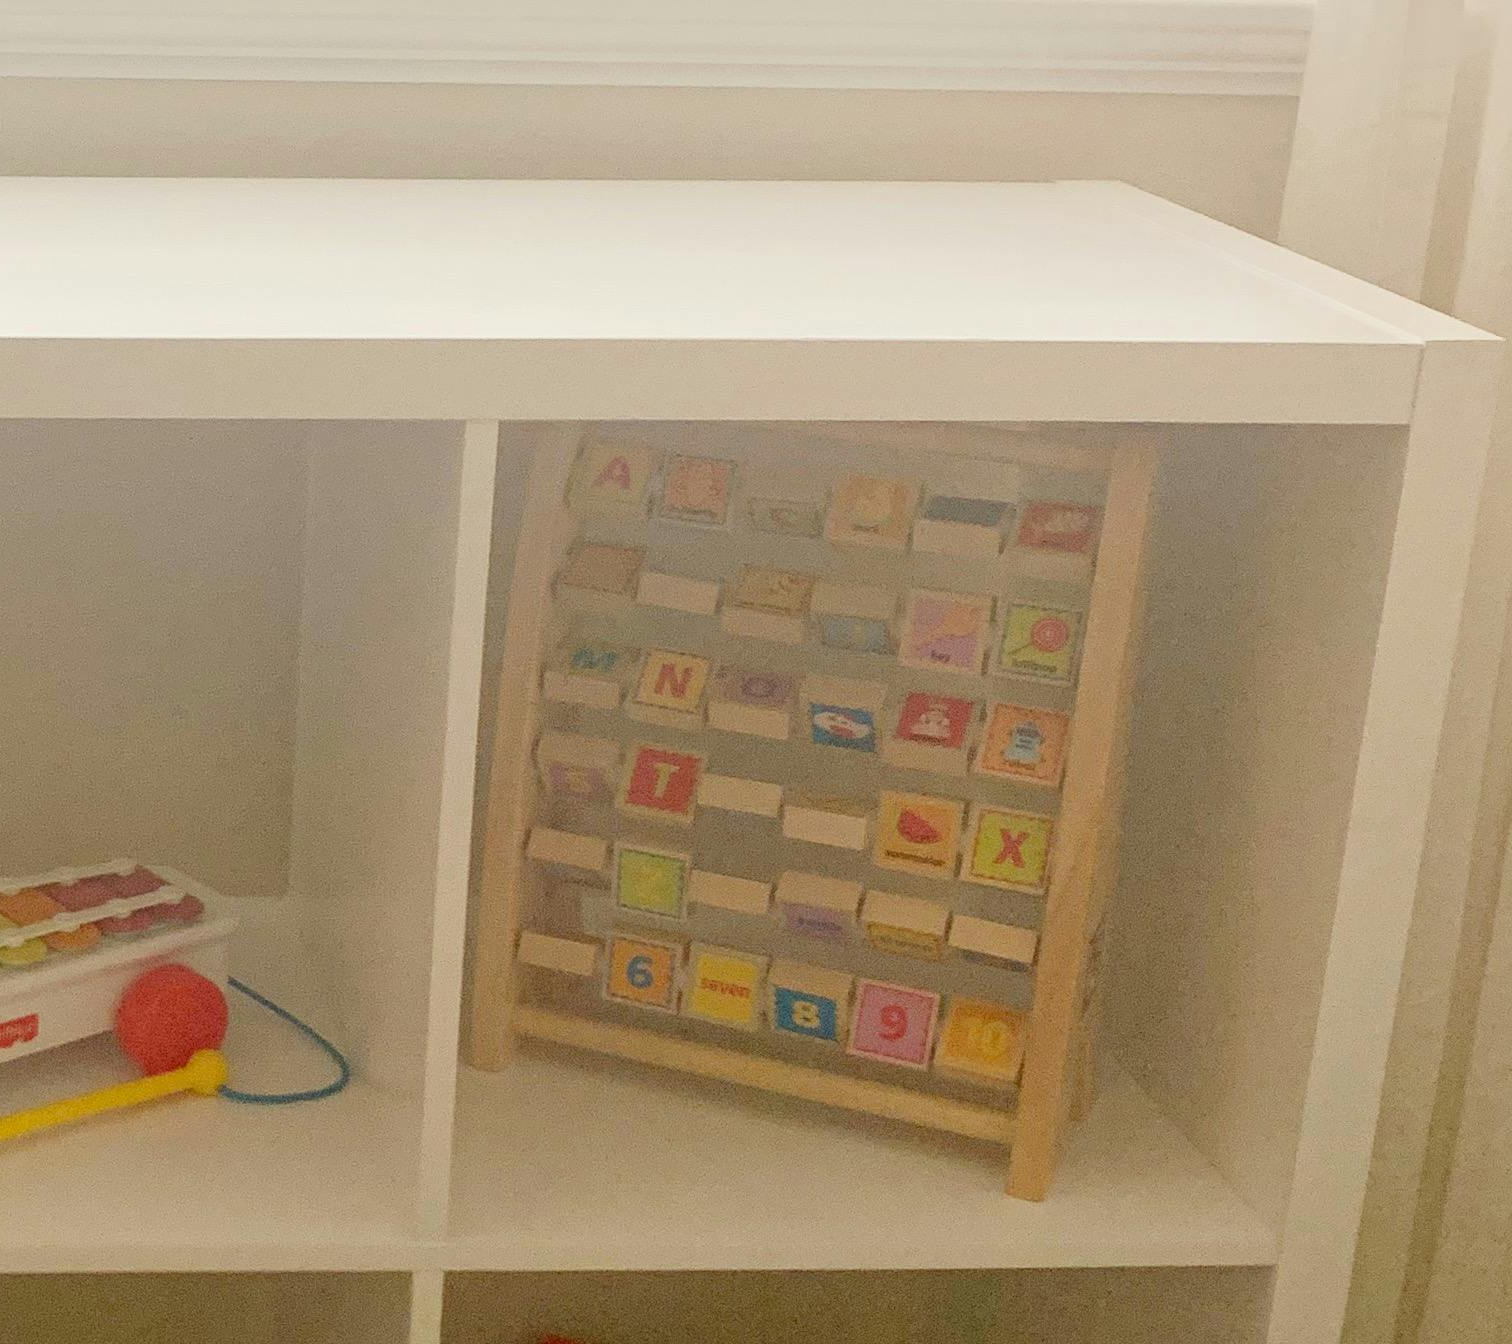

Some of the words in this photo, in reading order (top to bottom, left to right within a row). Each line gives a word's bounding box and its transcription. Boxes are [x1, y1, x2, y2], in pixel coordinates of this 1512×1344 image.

[591, 457, 631, 490] A
[654, 663, 693, 698] N
[653, 762, 681, 799] T
[992, 828, 1029, 869] X
[626, 955, 655, 989] 6
[701, 977, 752, 1000] seven
[791, 1000, 821, 1029] 8
[876, 1005, 909, 1043] 9
[961, 1017, 1010, 1058] 10
